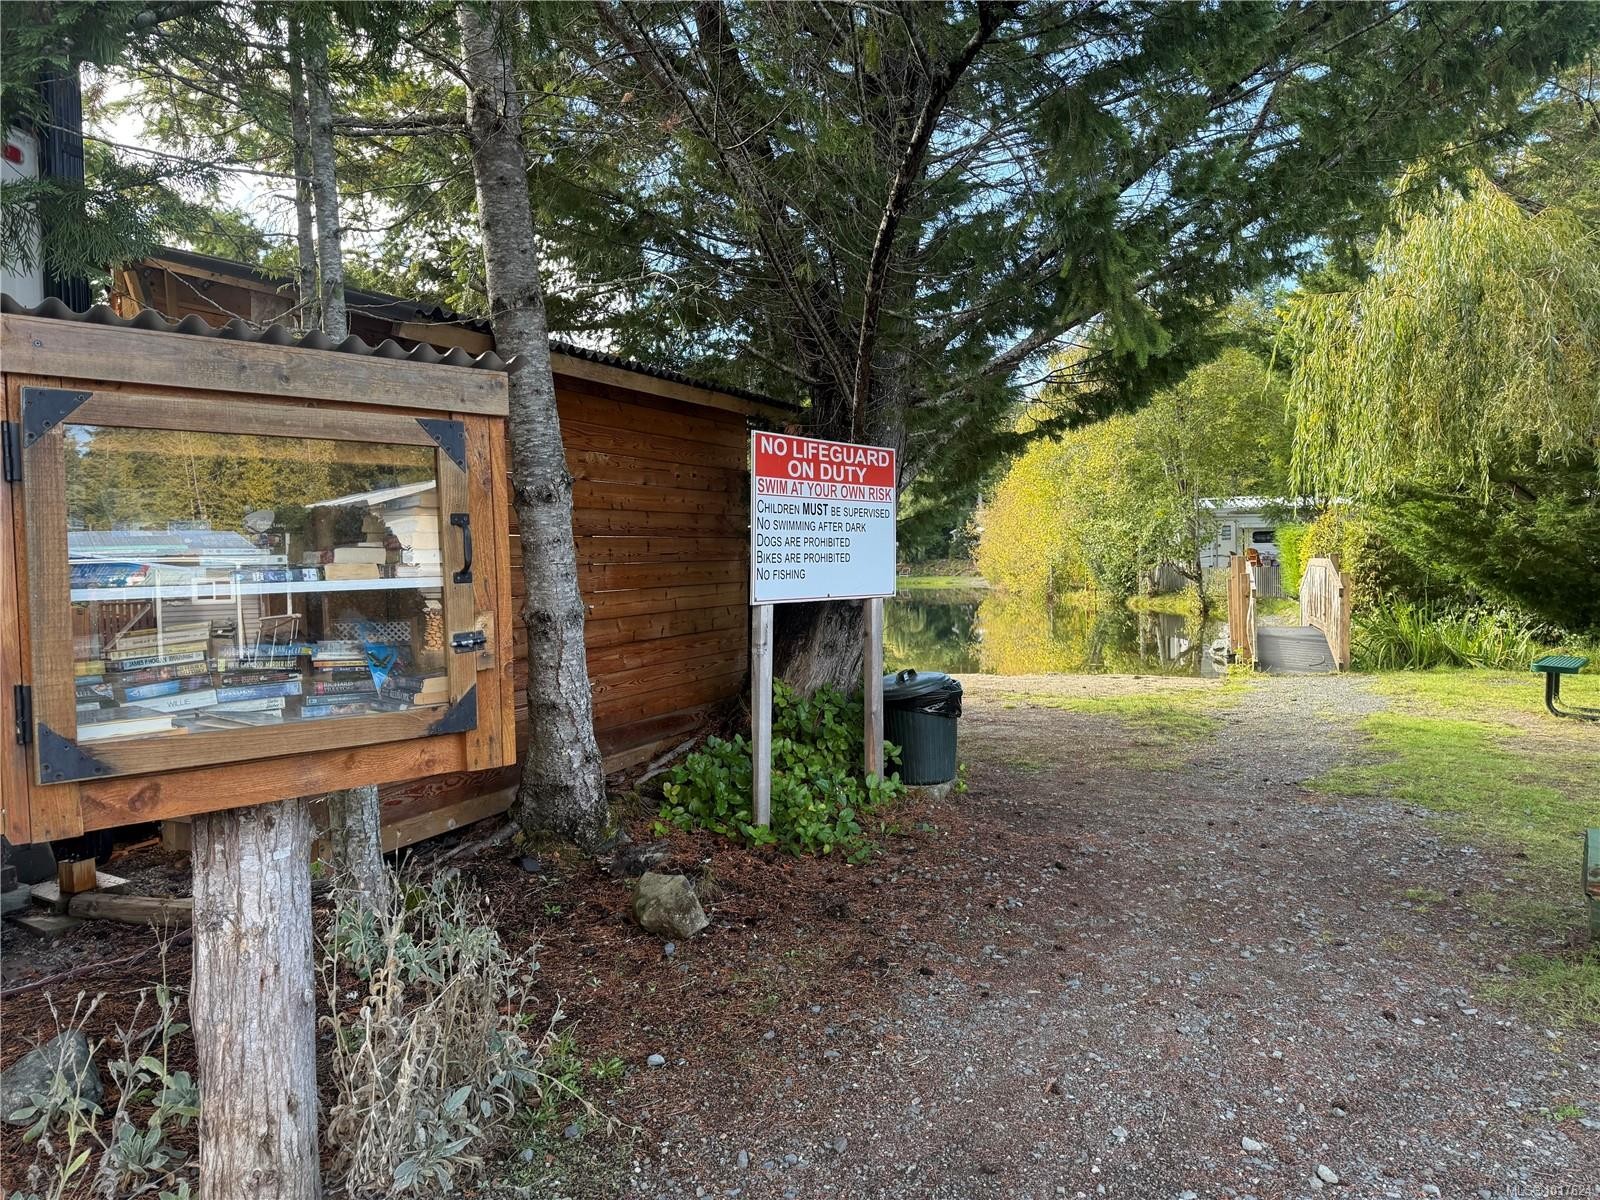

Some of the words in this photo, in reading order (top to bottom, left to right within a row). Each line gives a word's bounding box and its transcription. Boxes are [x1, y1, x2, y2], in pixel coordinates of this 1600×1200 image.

[761, 436, 787, 456] NO
[793, 441, 890, 467] LIFEGUARD
[788, 460, 814, 479] ON
[820, 463, 867, 483] DUTY
[757, 478, 788, 496] SWIM
[791, 482, 804, 495] AT
[807, 482, 837, 498] YOUR
[840, 485, 865, 500] OWN
[868, 487, 892, 501] RISK
[802, 503, 828, 516] MUST
[831, 506, 841, 517] BE
[843, 507, 890, 518] SUPERVISED
[773, 520, 815, 531] SWIMMING
[818, 522, 843, 532] AFTER
[845, 522, 866, 533] DARK
[784, 536, 800, 547] ARE
[803, 537, 851, 547] PROHIBITED
[784, 552, 800, 563] ARE
[803, 553, 851, 563] PROHIBITED
[772, 569, 806, 580] FISHING
